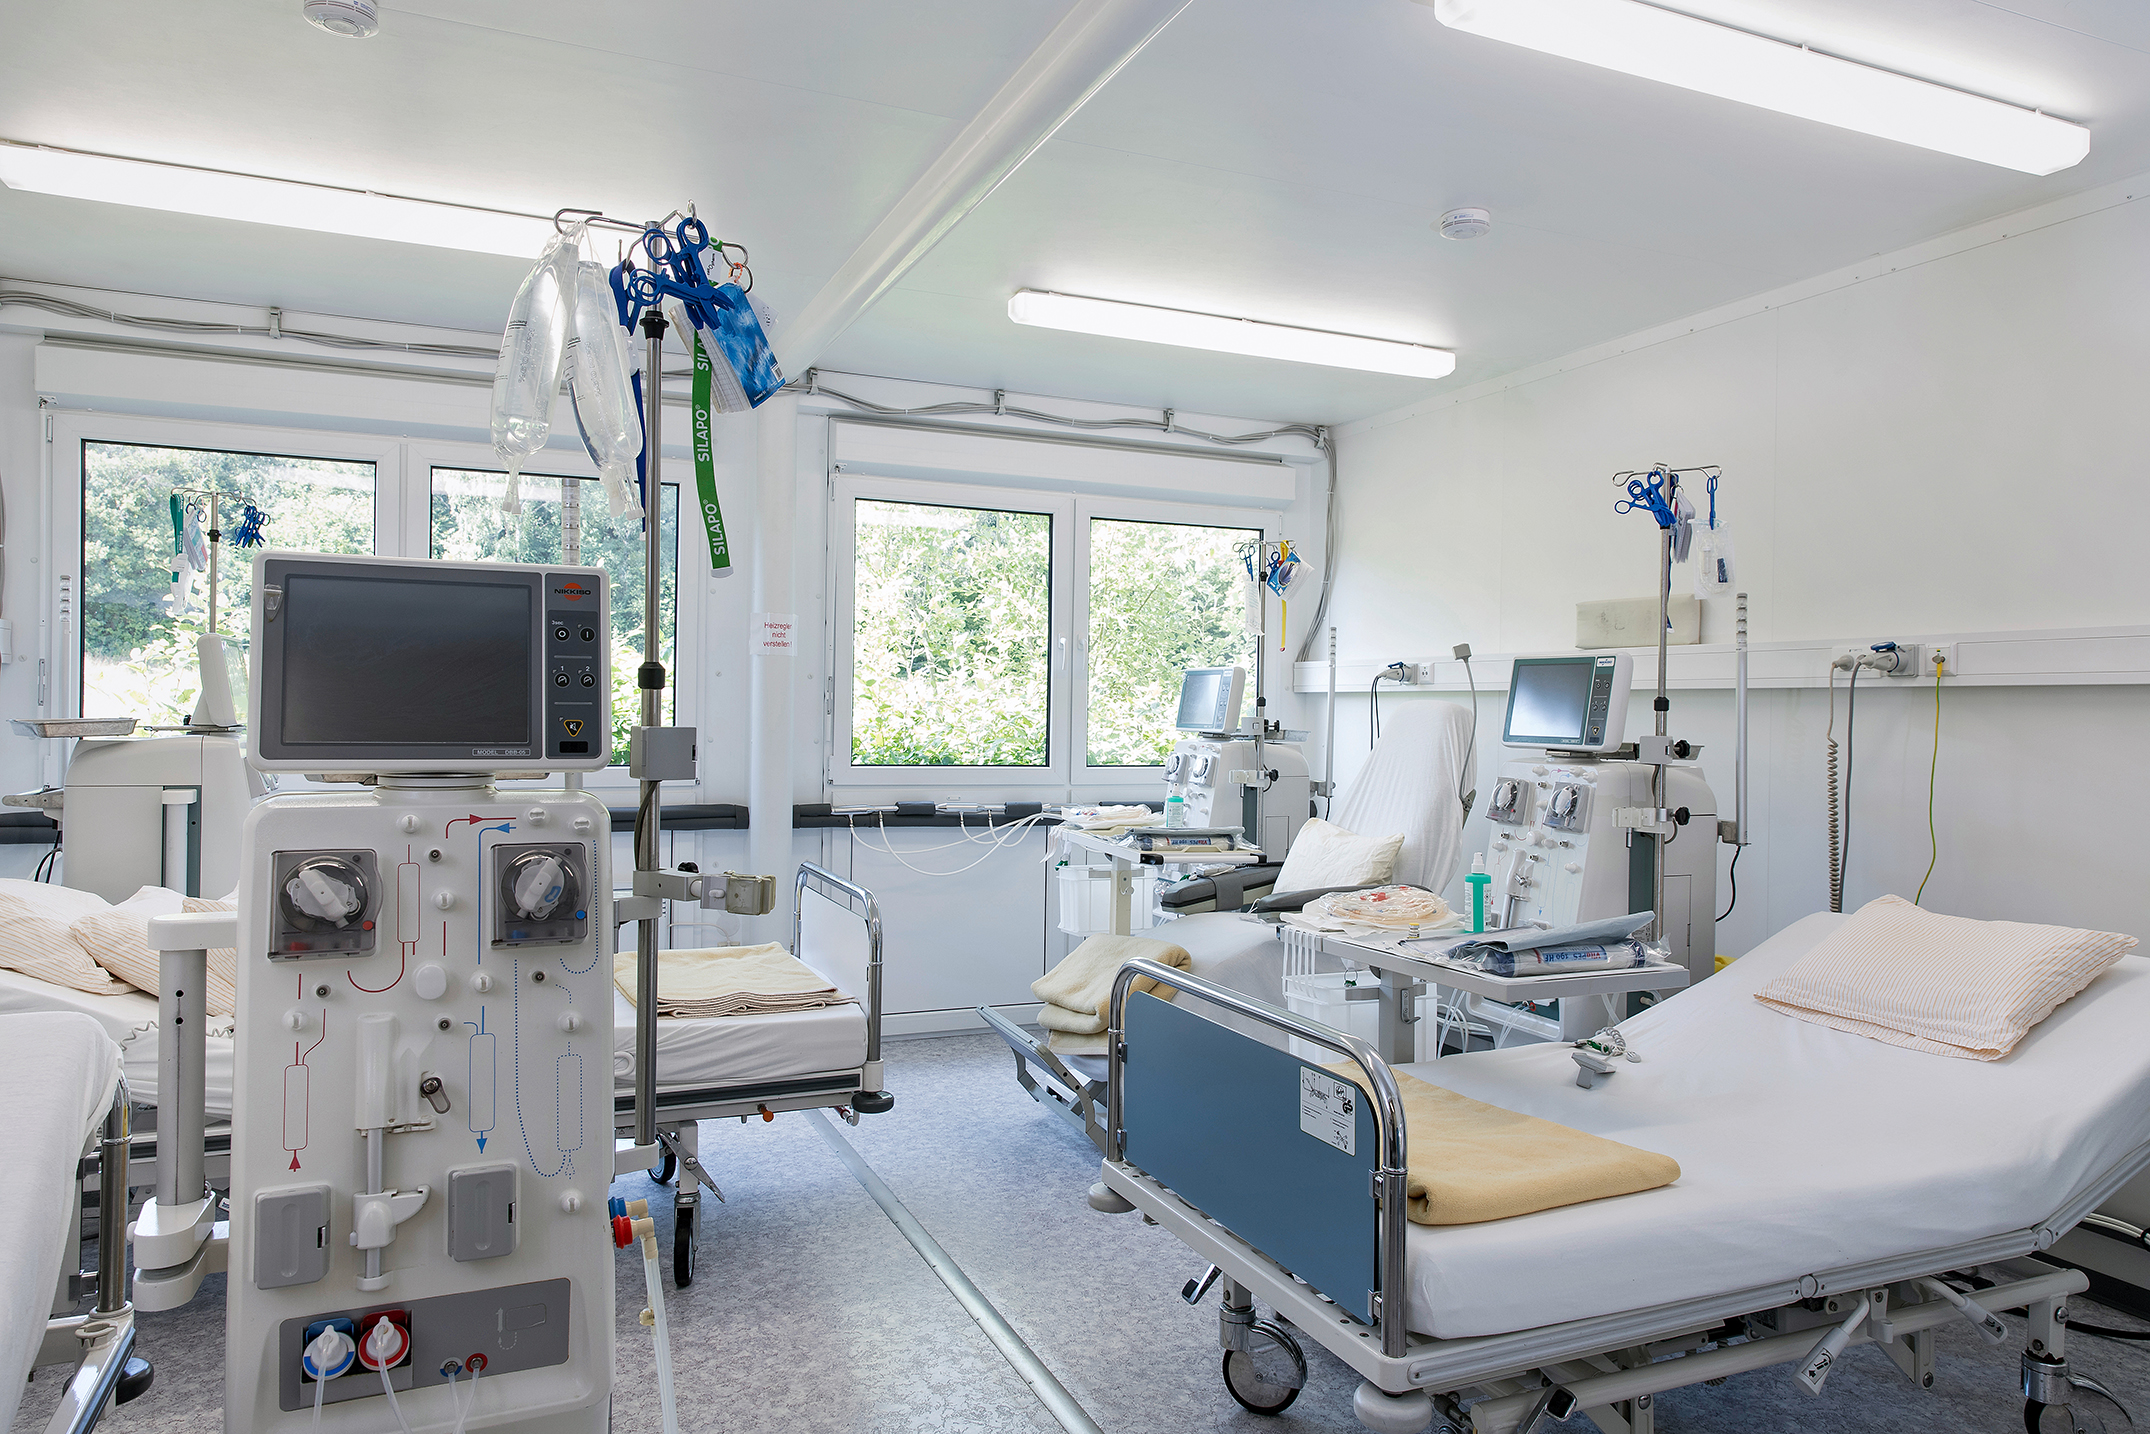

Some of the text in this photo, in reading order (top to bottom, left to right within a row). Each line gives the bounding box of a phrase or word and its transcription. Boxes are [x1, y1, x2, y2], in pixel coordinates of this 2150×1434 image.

[554, 588, 592, 596] NIKKISO
[764, 622, 792, 631] Heizregler
[1555, 952, 1569, 960] 190
